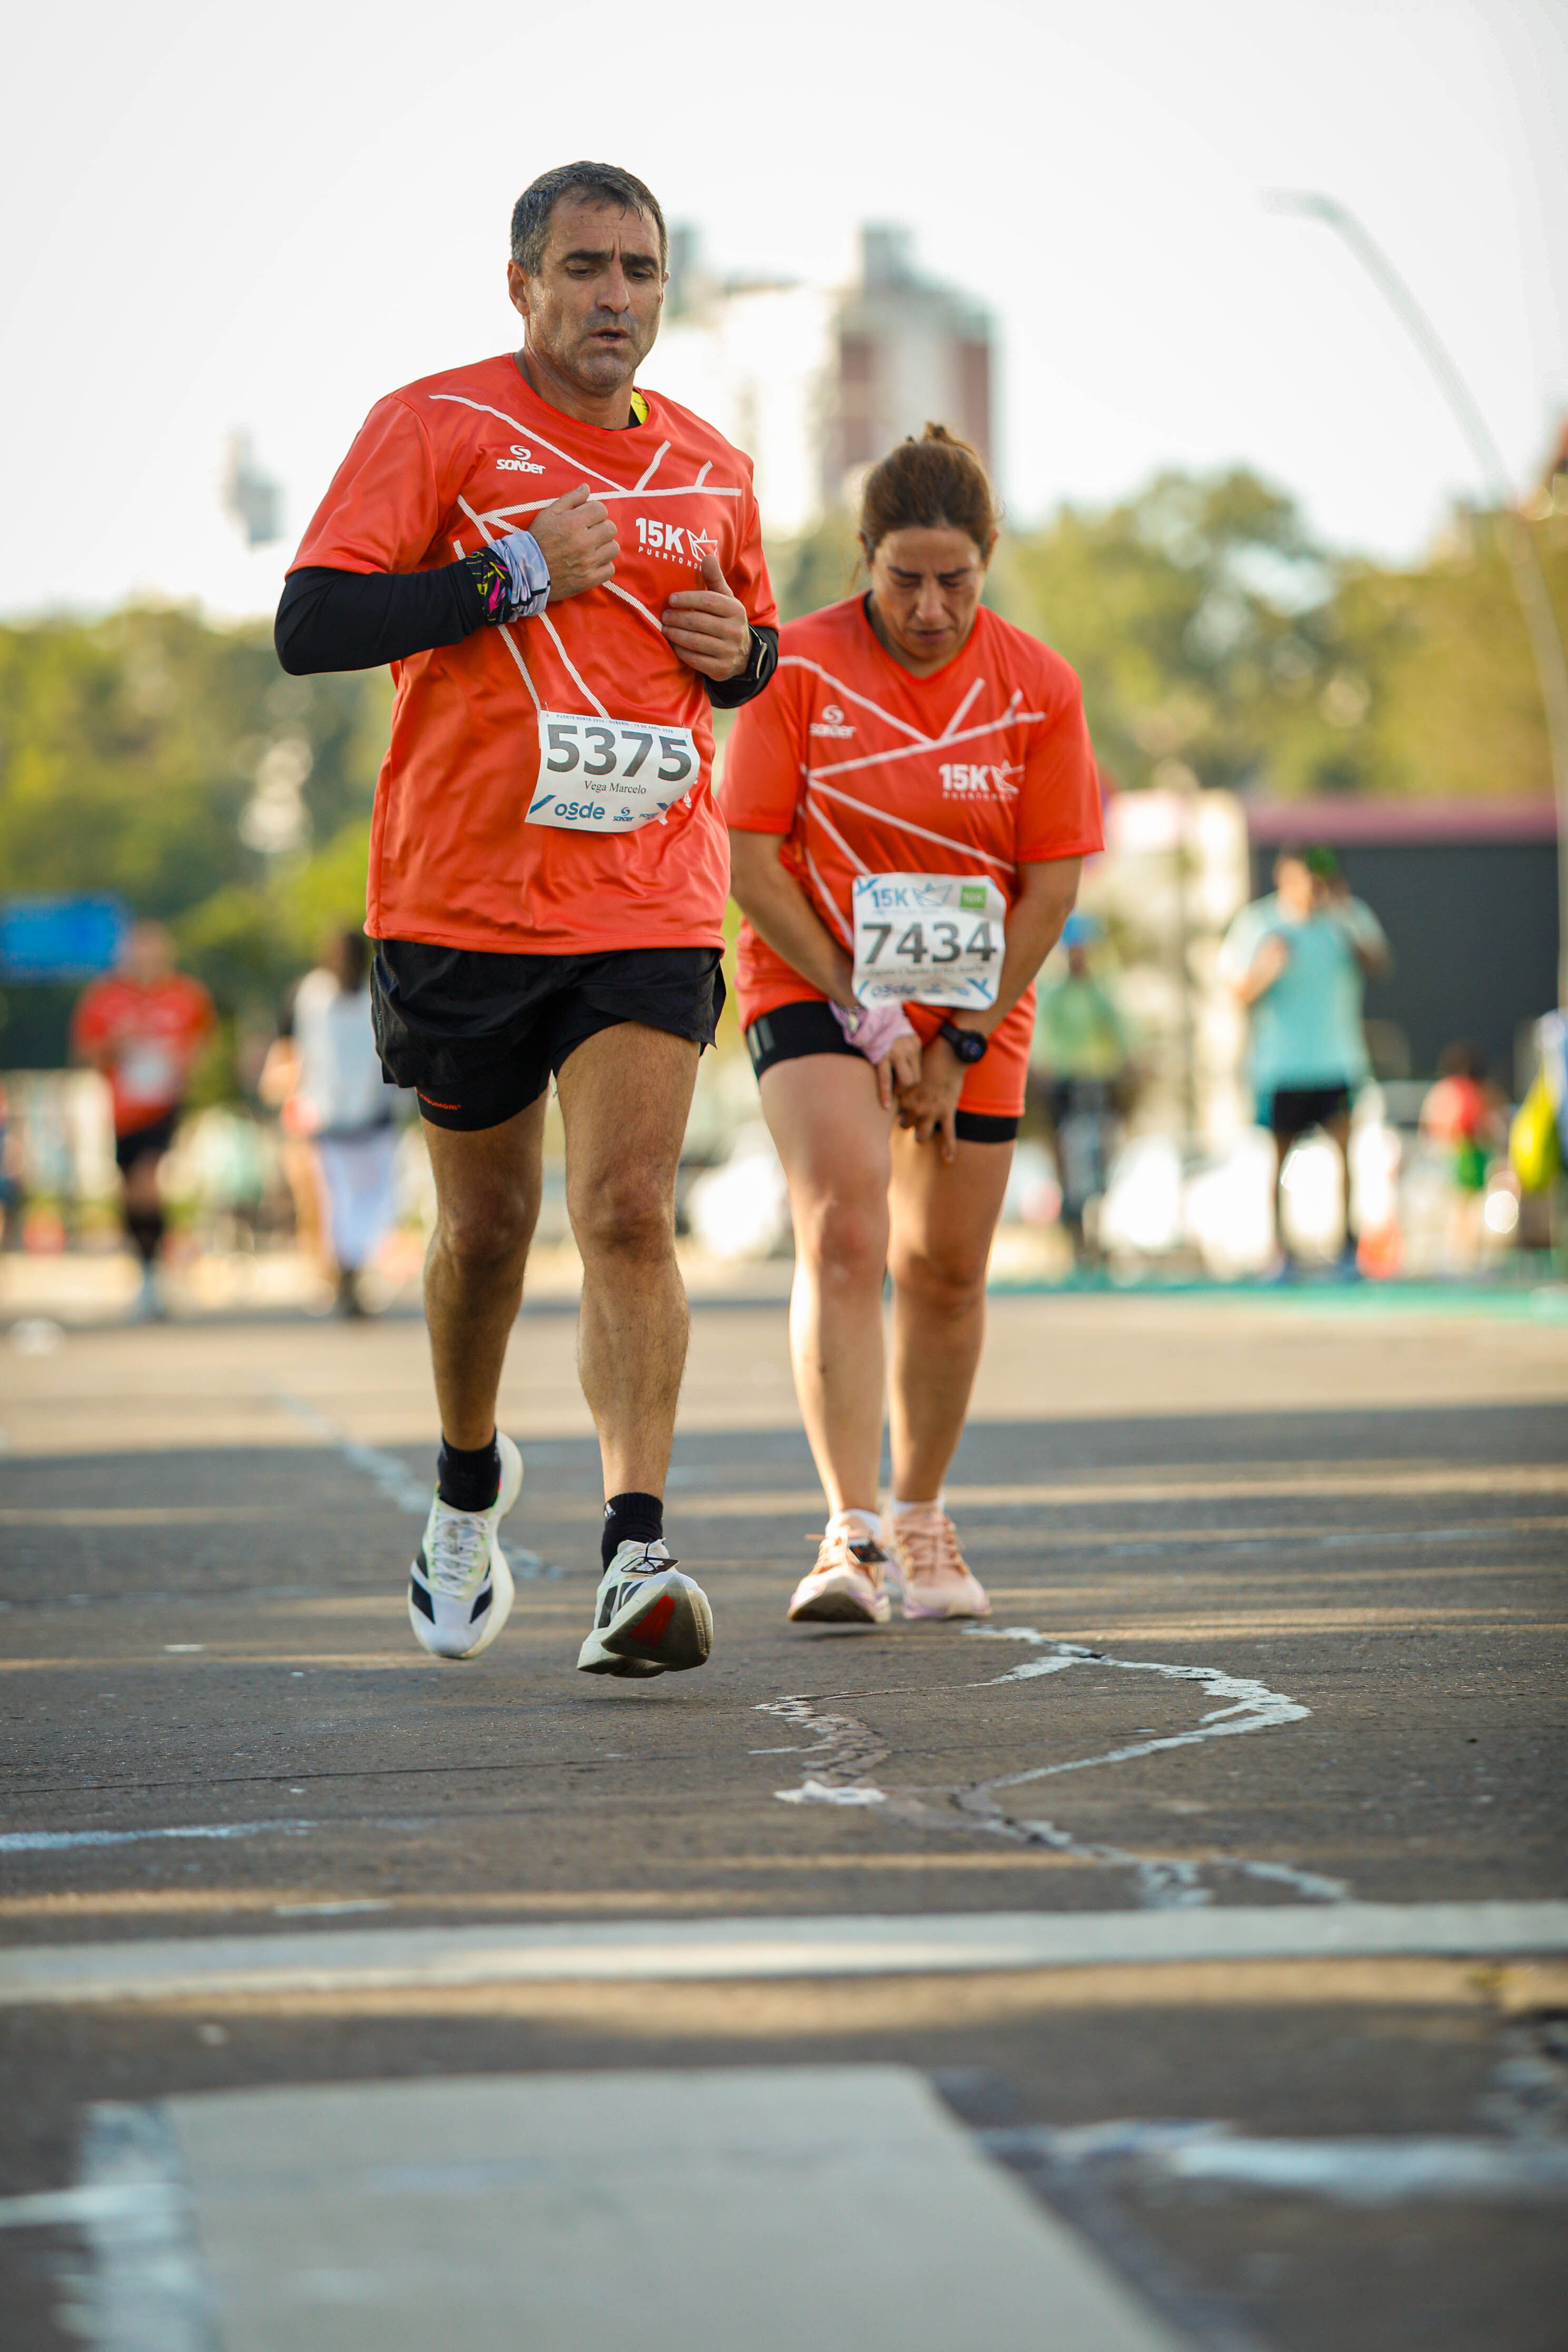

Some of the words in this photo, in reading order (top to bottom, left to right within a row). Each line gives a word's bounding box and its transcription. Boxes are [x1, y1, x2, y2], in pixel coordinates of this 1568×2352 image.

[635, 517, 684, 555] 15K
[638, 546, 683, 564] PUERTO
[546, 724, 692, 781] 5375
[584, 780, 606, 793] Vega
[609, 782, 646, 794] Marcelo
[939, 763, 990, 791] 15K
[554, 801, 605, 820] osde
[871, 888, 909, 908] 15K
[862, 921, 997, 964] 7434
